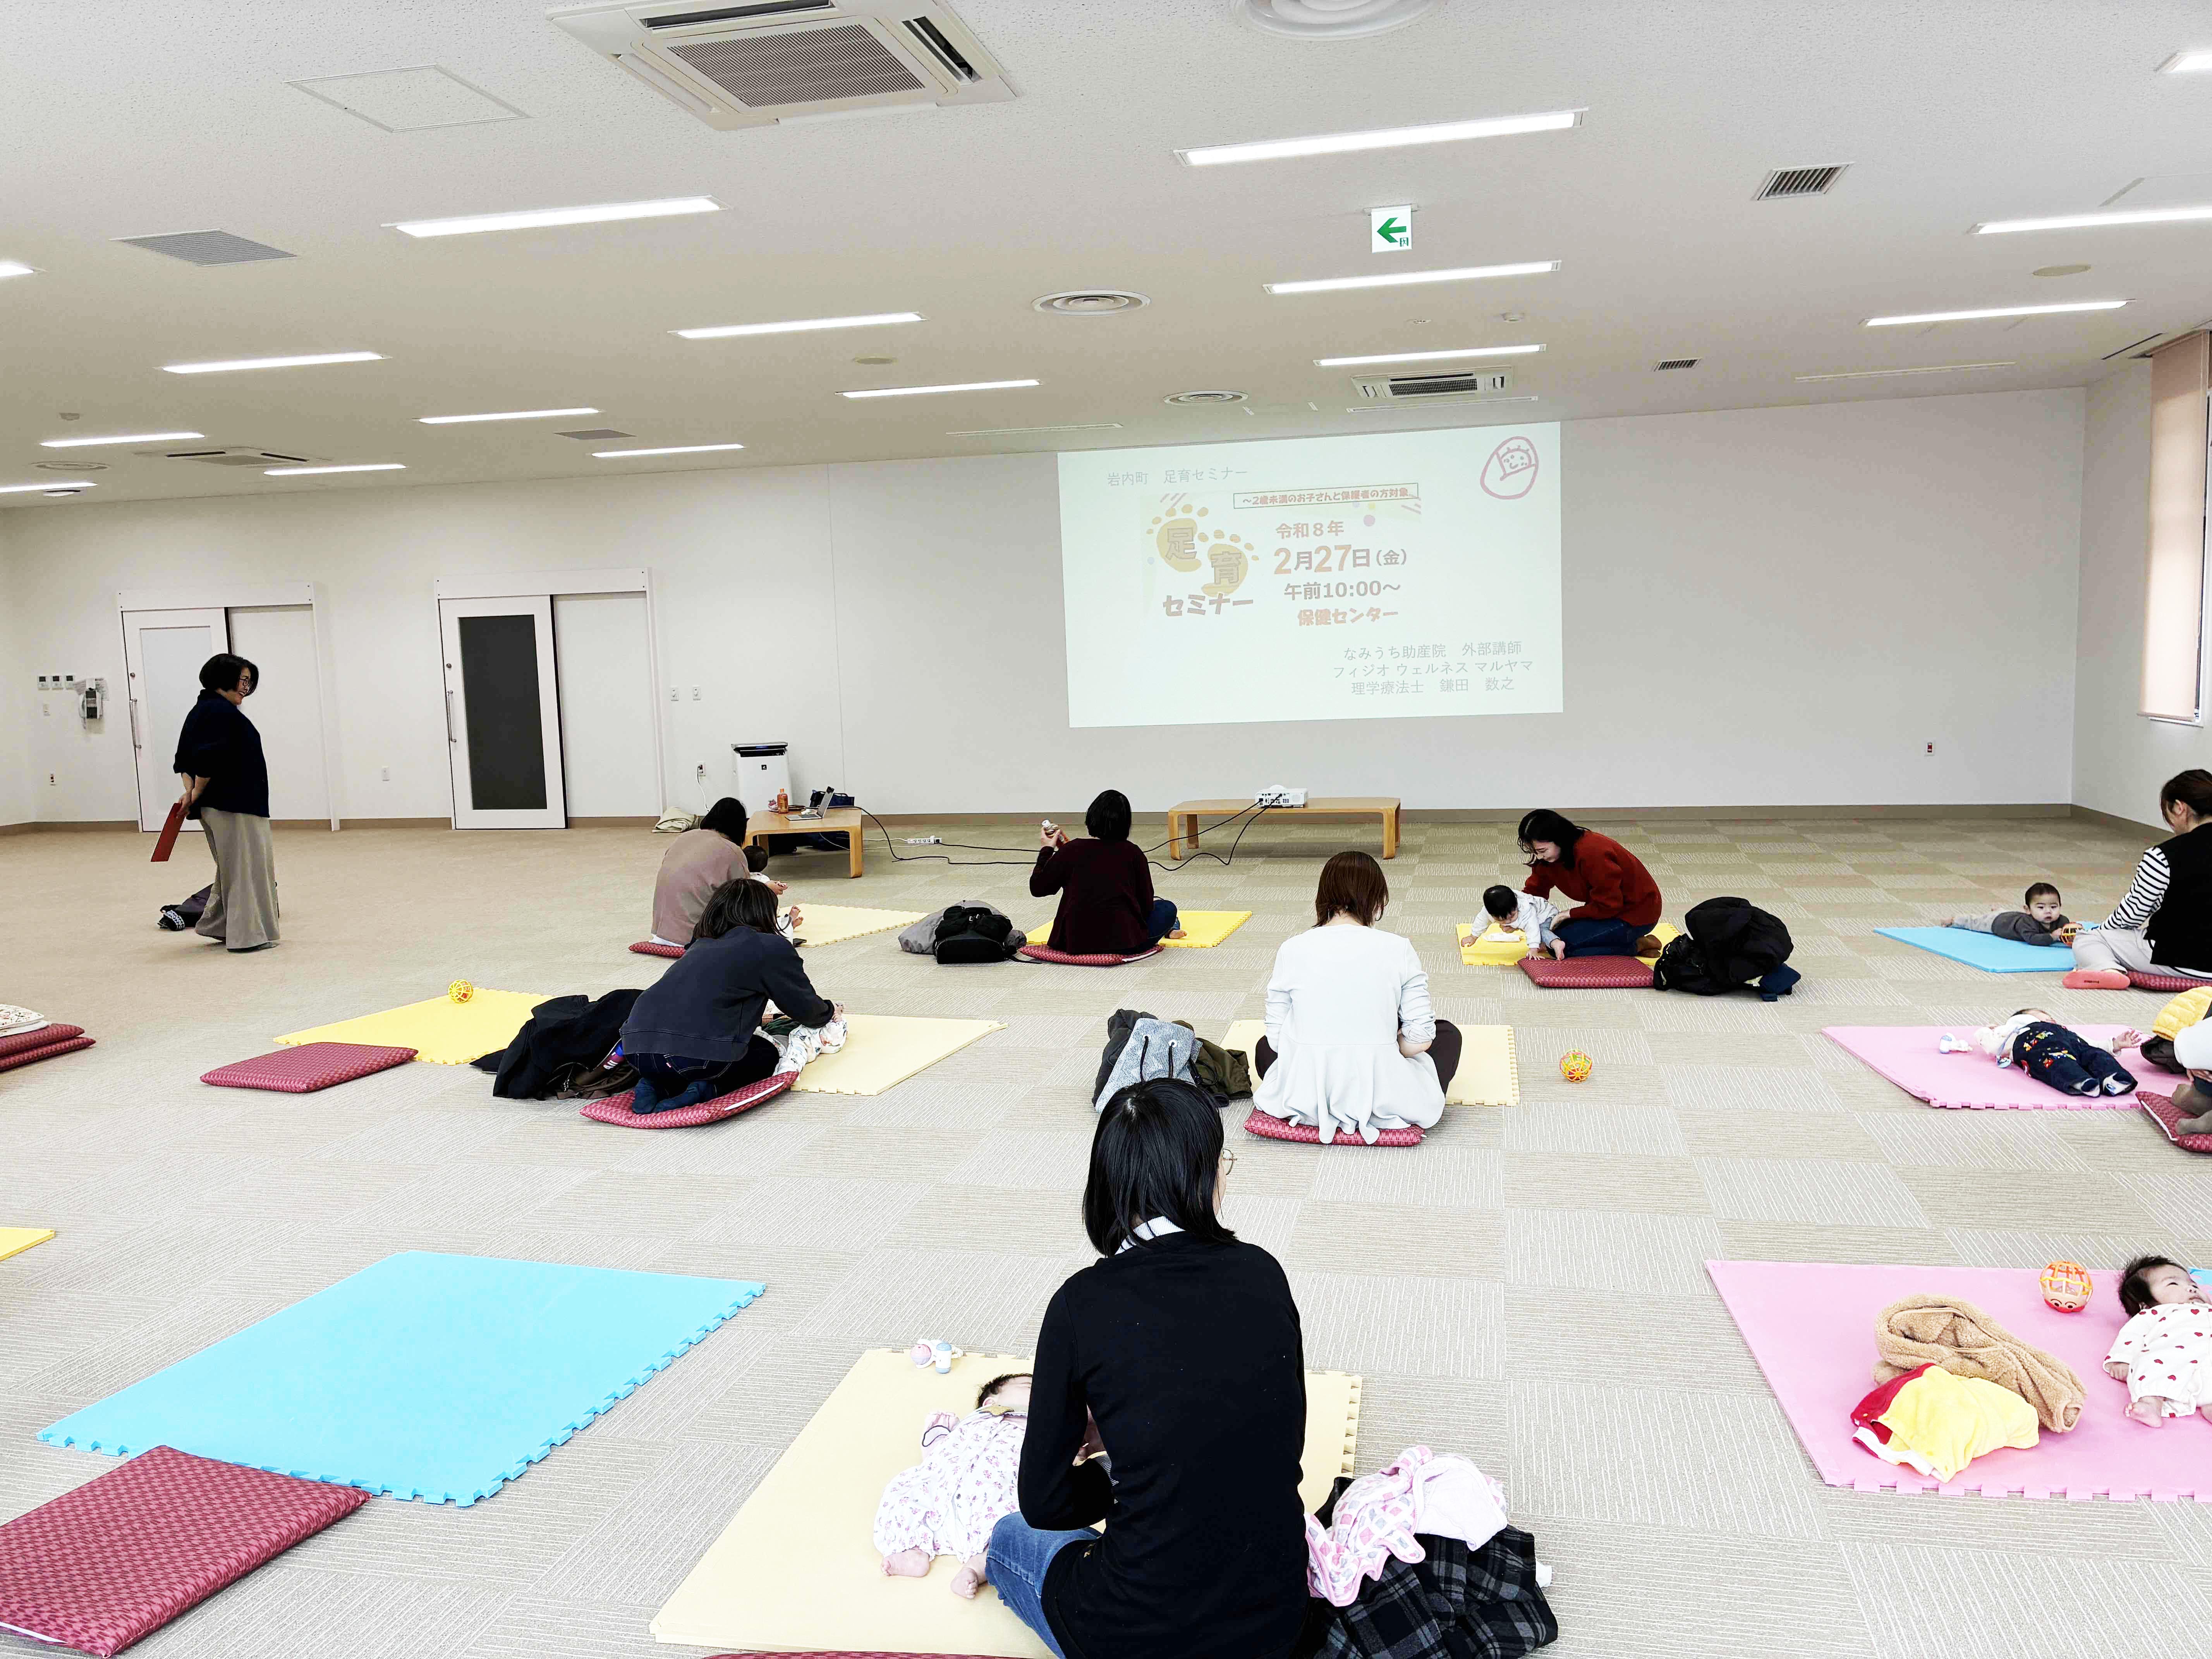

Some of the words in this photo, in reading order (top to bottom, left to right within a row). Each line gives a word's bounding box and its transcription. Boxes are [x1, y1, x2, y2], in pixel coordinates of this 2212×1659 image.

[1107, 472, 1149, 486] 岩内町
[1163, 467, 1248, 484] 足育セミナー
[1275, 520, 1344, 539] 令和8年
[1163, 592, 1254, 617] セミナー
[1297, 606, 1398, 626] 保健センター
[1344, 643, 1446, 660] なみうち助産院
[1462, 641, 1522, 656] 外部講師
[1334, 664, 1389, 678] フィジオ
[1397, 661, 1468, 676] ウェルネス
[1475, 659, 1533, 672] マルヤマ
[1351, 679, 1424, 695] 理学療法士
[1439, 678, 1468, 693] 鎌田
[1485, 676, 1515, 691] 数之
